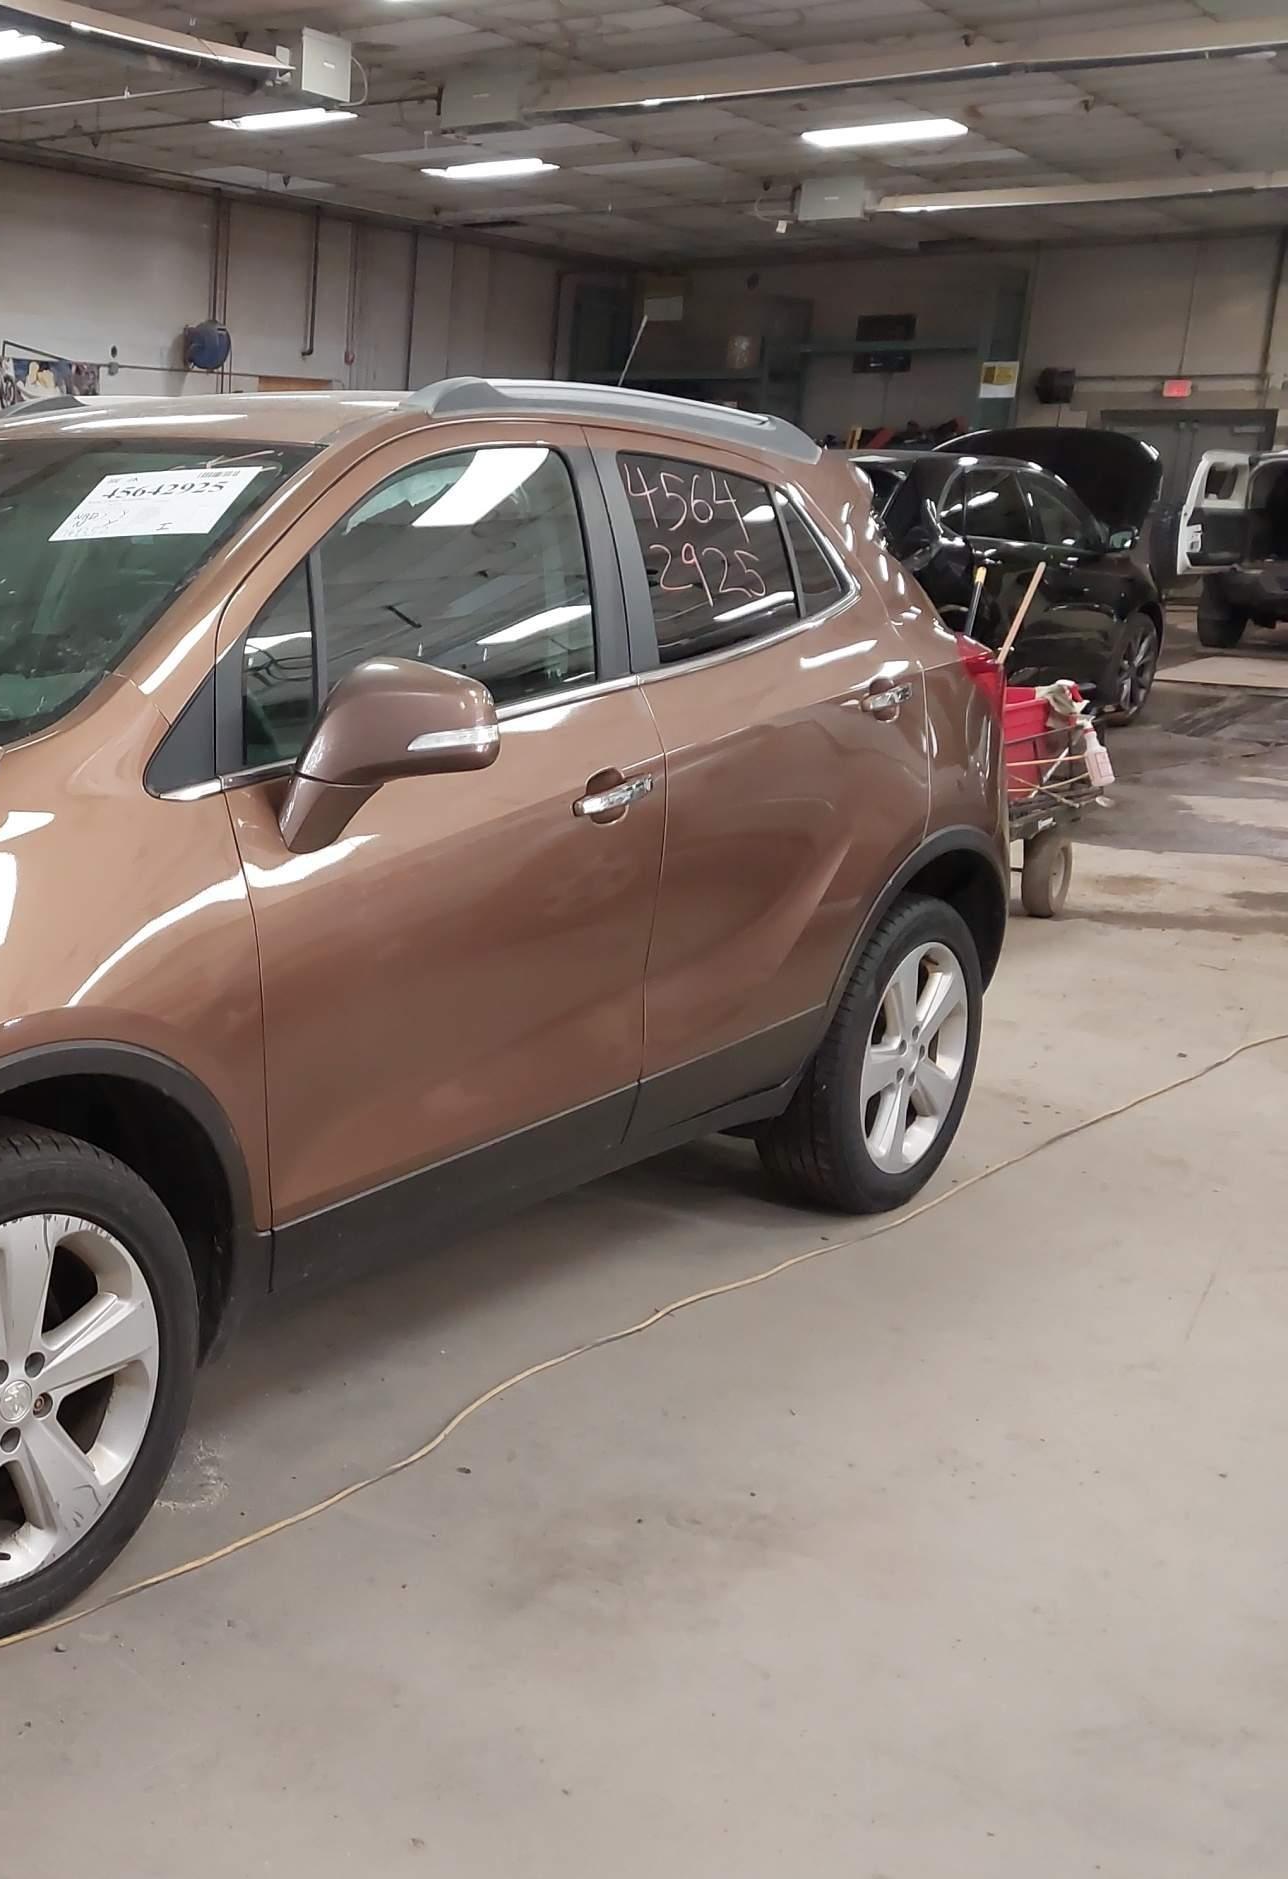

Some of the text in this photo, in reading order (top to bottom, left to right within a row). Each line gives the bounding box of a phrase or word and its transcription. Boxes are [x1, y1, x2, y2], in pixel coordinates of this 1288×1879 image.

[102, 480, 228, 499] 45642925
[624, 463, 751, 543] 4564
[648, 542, 767, 608] 2925
